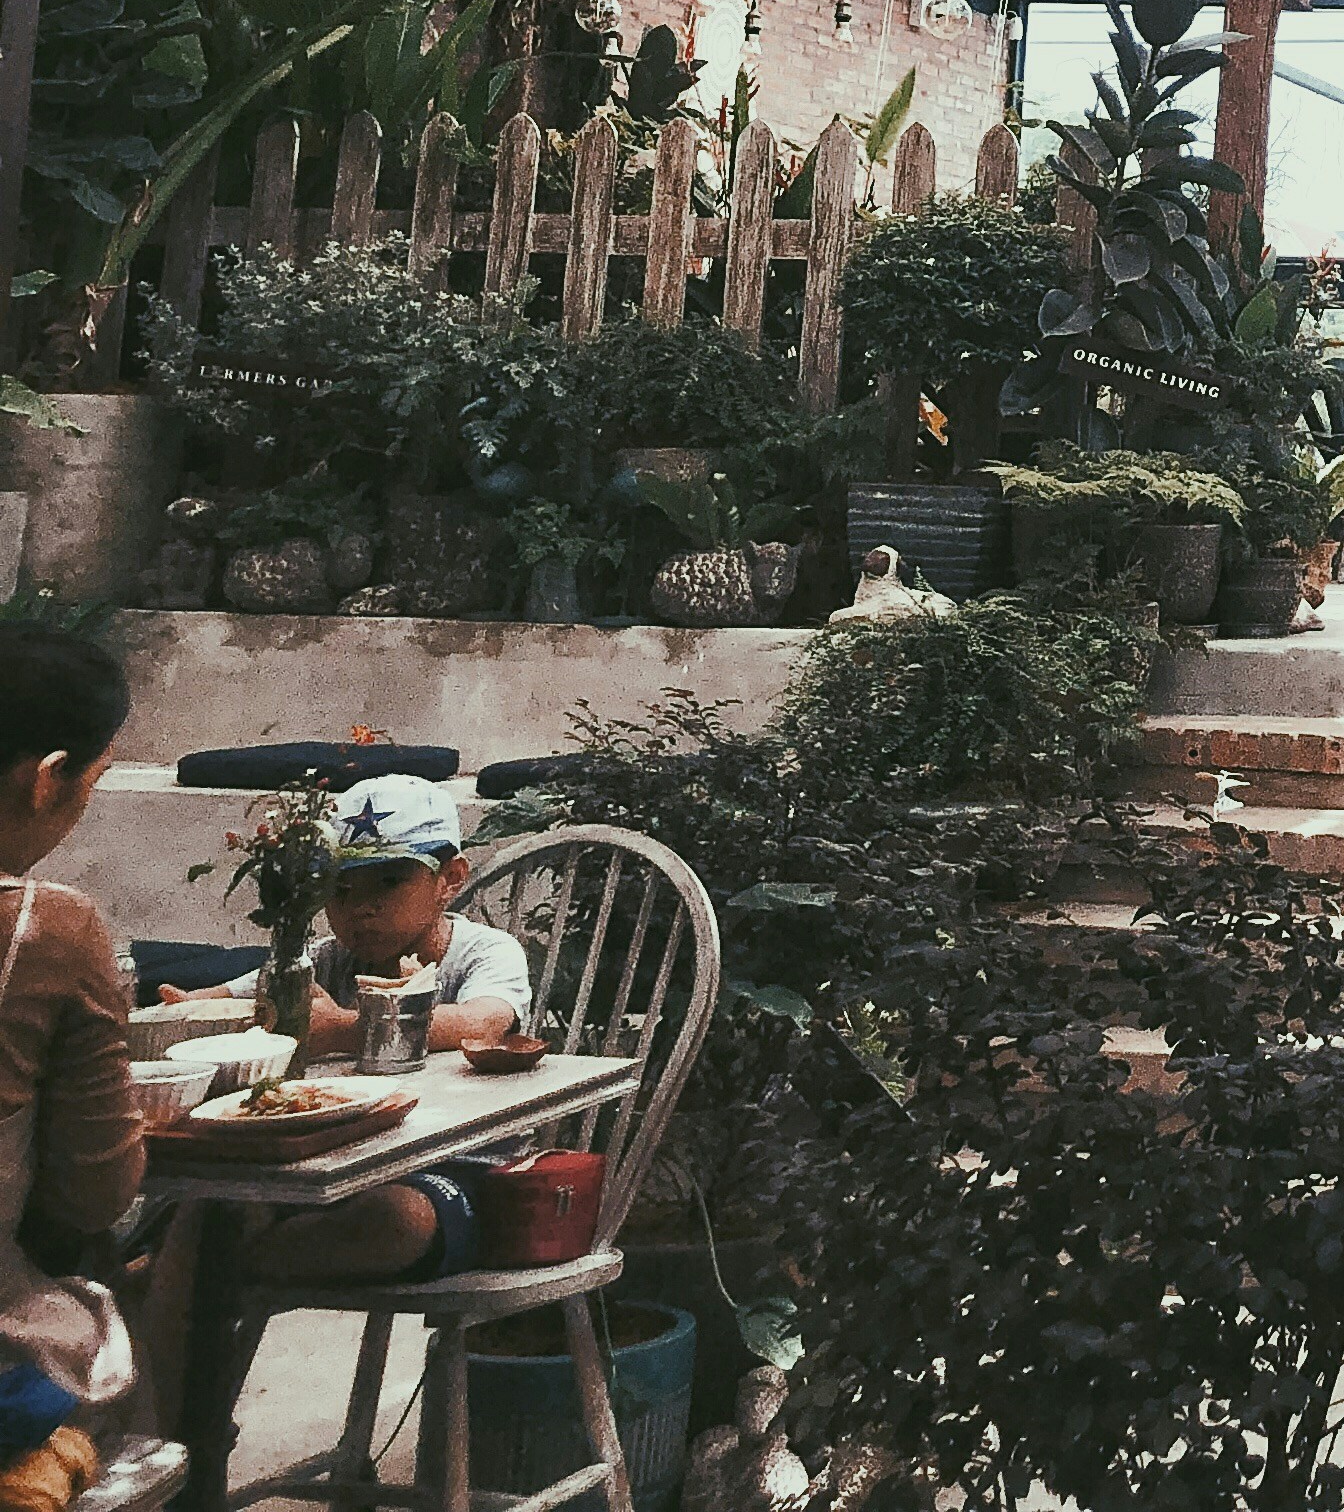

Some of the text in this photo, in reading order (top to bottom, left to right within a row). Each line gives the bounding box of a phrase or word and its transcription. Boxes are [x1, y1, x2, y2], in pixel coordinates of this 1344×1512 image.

[200, 365, 287, 386] RMERS
[1073, 349, 1220, 398] ORGANIC LIVING
